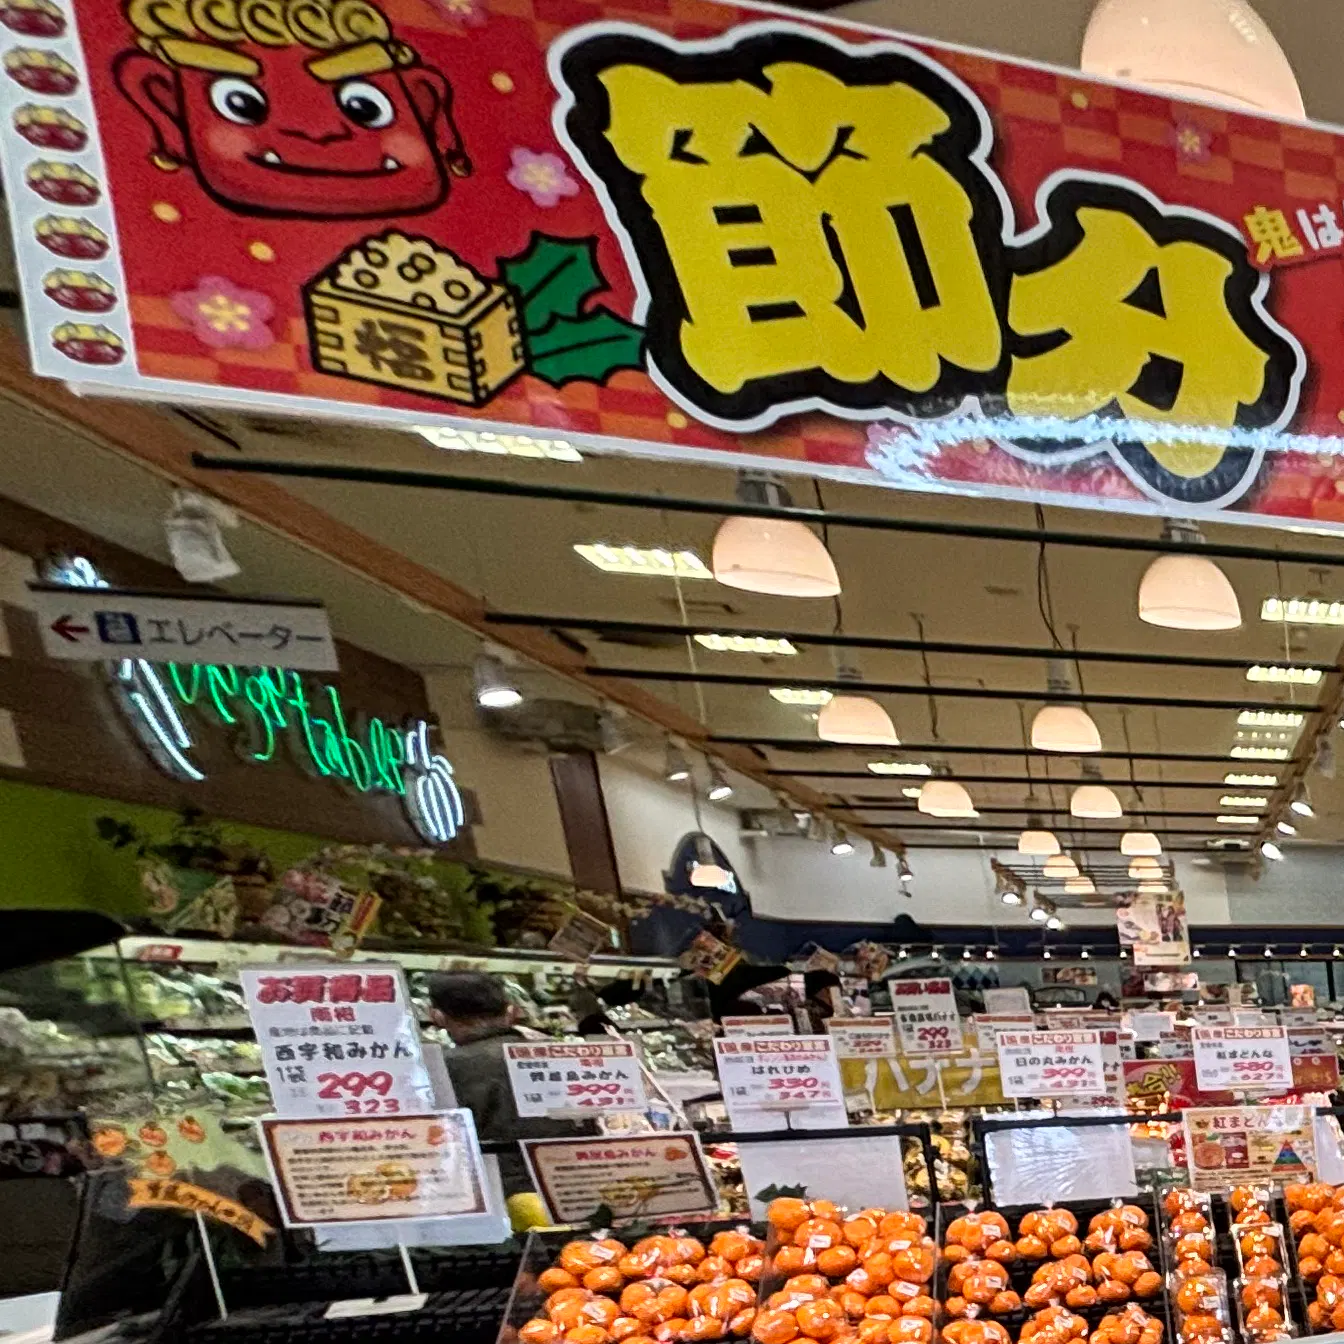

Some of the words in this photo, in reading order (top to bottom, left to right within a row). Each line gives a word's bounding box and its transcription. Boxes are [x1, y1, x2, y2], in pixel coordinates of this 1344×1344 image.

[598, 64, 1266, 476] 節分
[148, 617, 324, 650] エレベーター
[917, 1026, 949, 1041] 299
[928, 1039, 952, 1049] 323
[1216, 1051, 1274, 1060] 紅まどんな
[752, 1065, 811, 1075] はれひめ
[1232, 1061, 1274, 1072] 580
[316, 1070, 394, 1099] 299
[344, 1098, 401, 1114] 323
